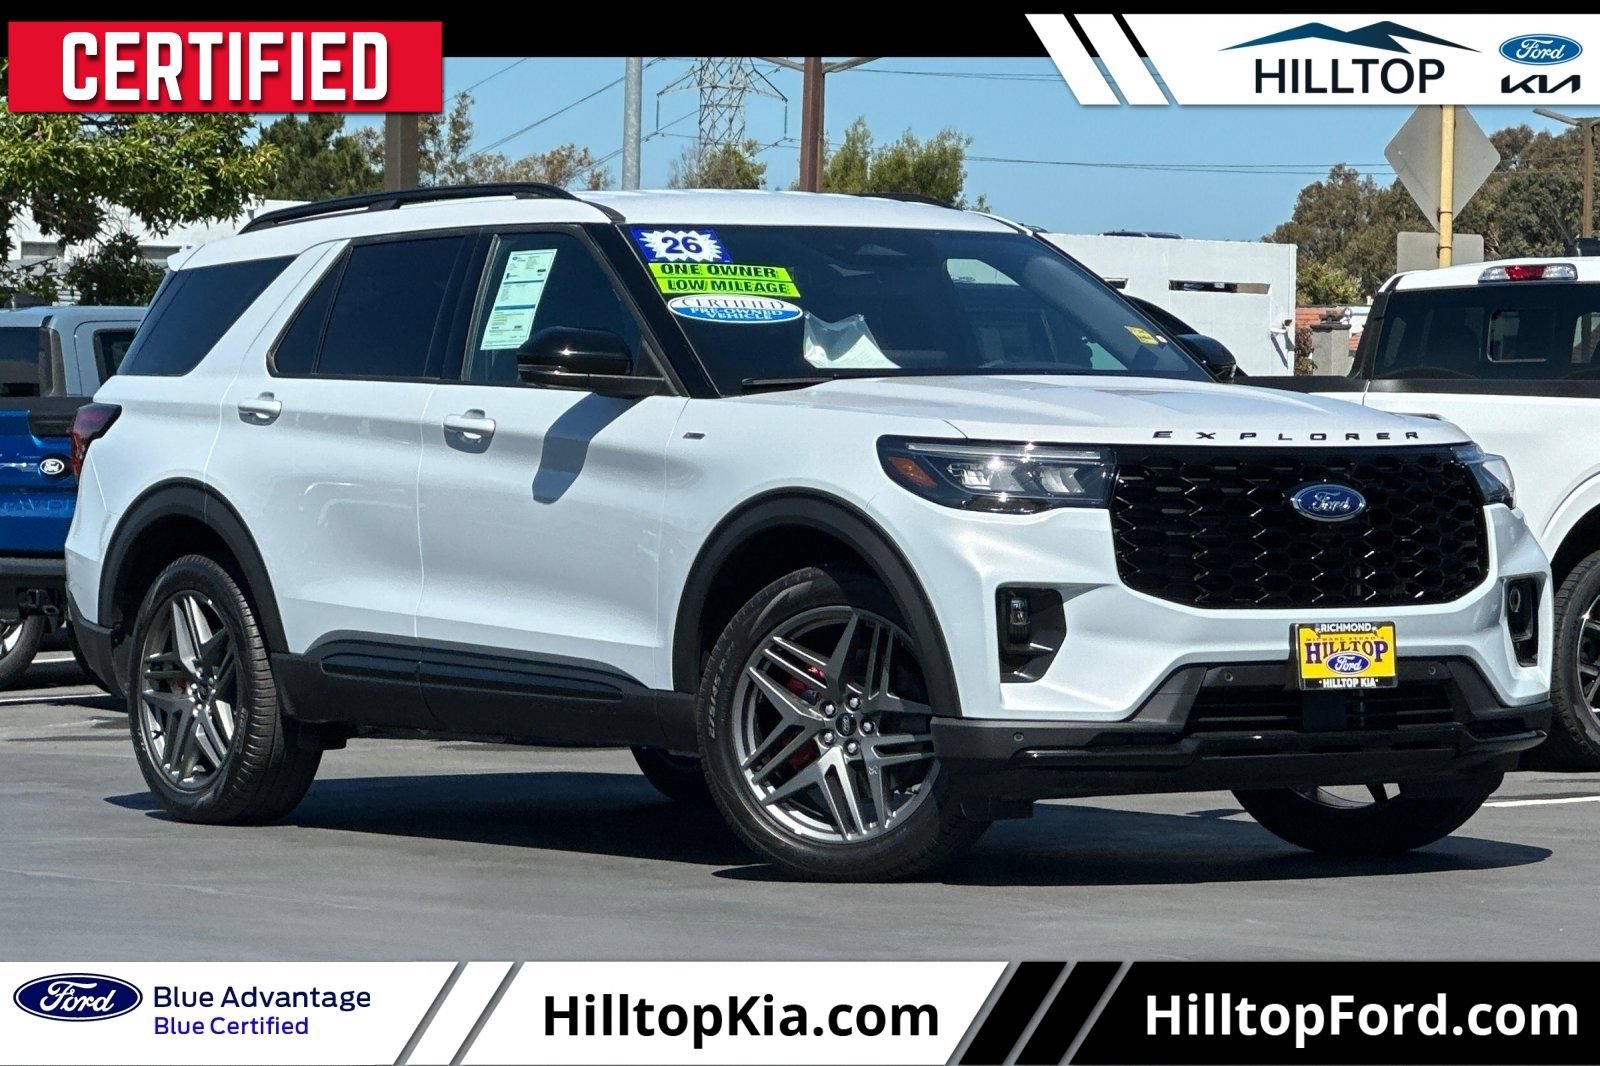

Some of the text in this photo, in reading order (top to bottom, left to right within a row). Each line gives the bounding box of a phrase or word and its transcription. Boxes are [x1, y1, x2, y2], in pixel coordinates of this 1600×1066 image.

[660, 236, 703, 254] 26
[660, 263, 778, 279] ONE OWNER
[667, 279, 789, 294] LOW MILEAGE
[682, 297, 784, 309] CERTIFIED
[690, 307, 783, 316] PRE-OWNED
[706, 311, 773, 321] VEHICLE
[1152, 429, 1420, 442] EXPLORER
[1311, 491, 1352, 512] Ford
[1320, 623, 1372, 633] RICHMOND
[1305, 640, 1388, 664] HILLTOP
[1334, 655, 1363, 671] Ford
[1322, 677, 1377, 688] HILLTOP KIA
